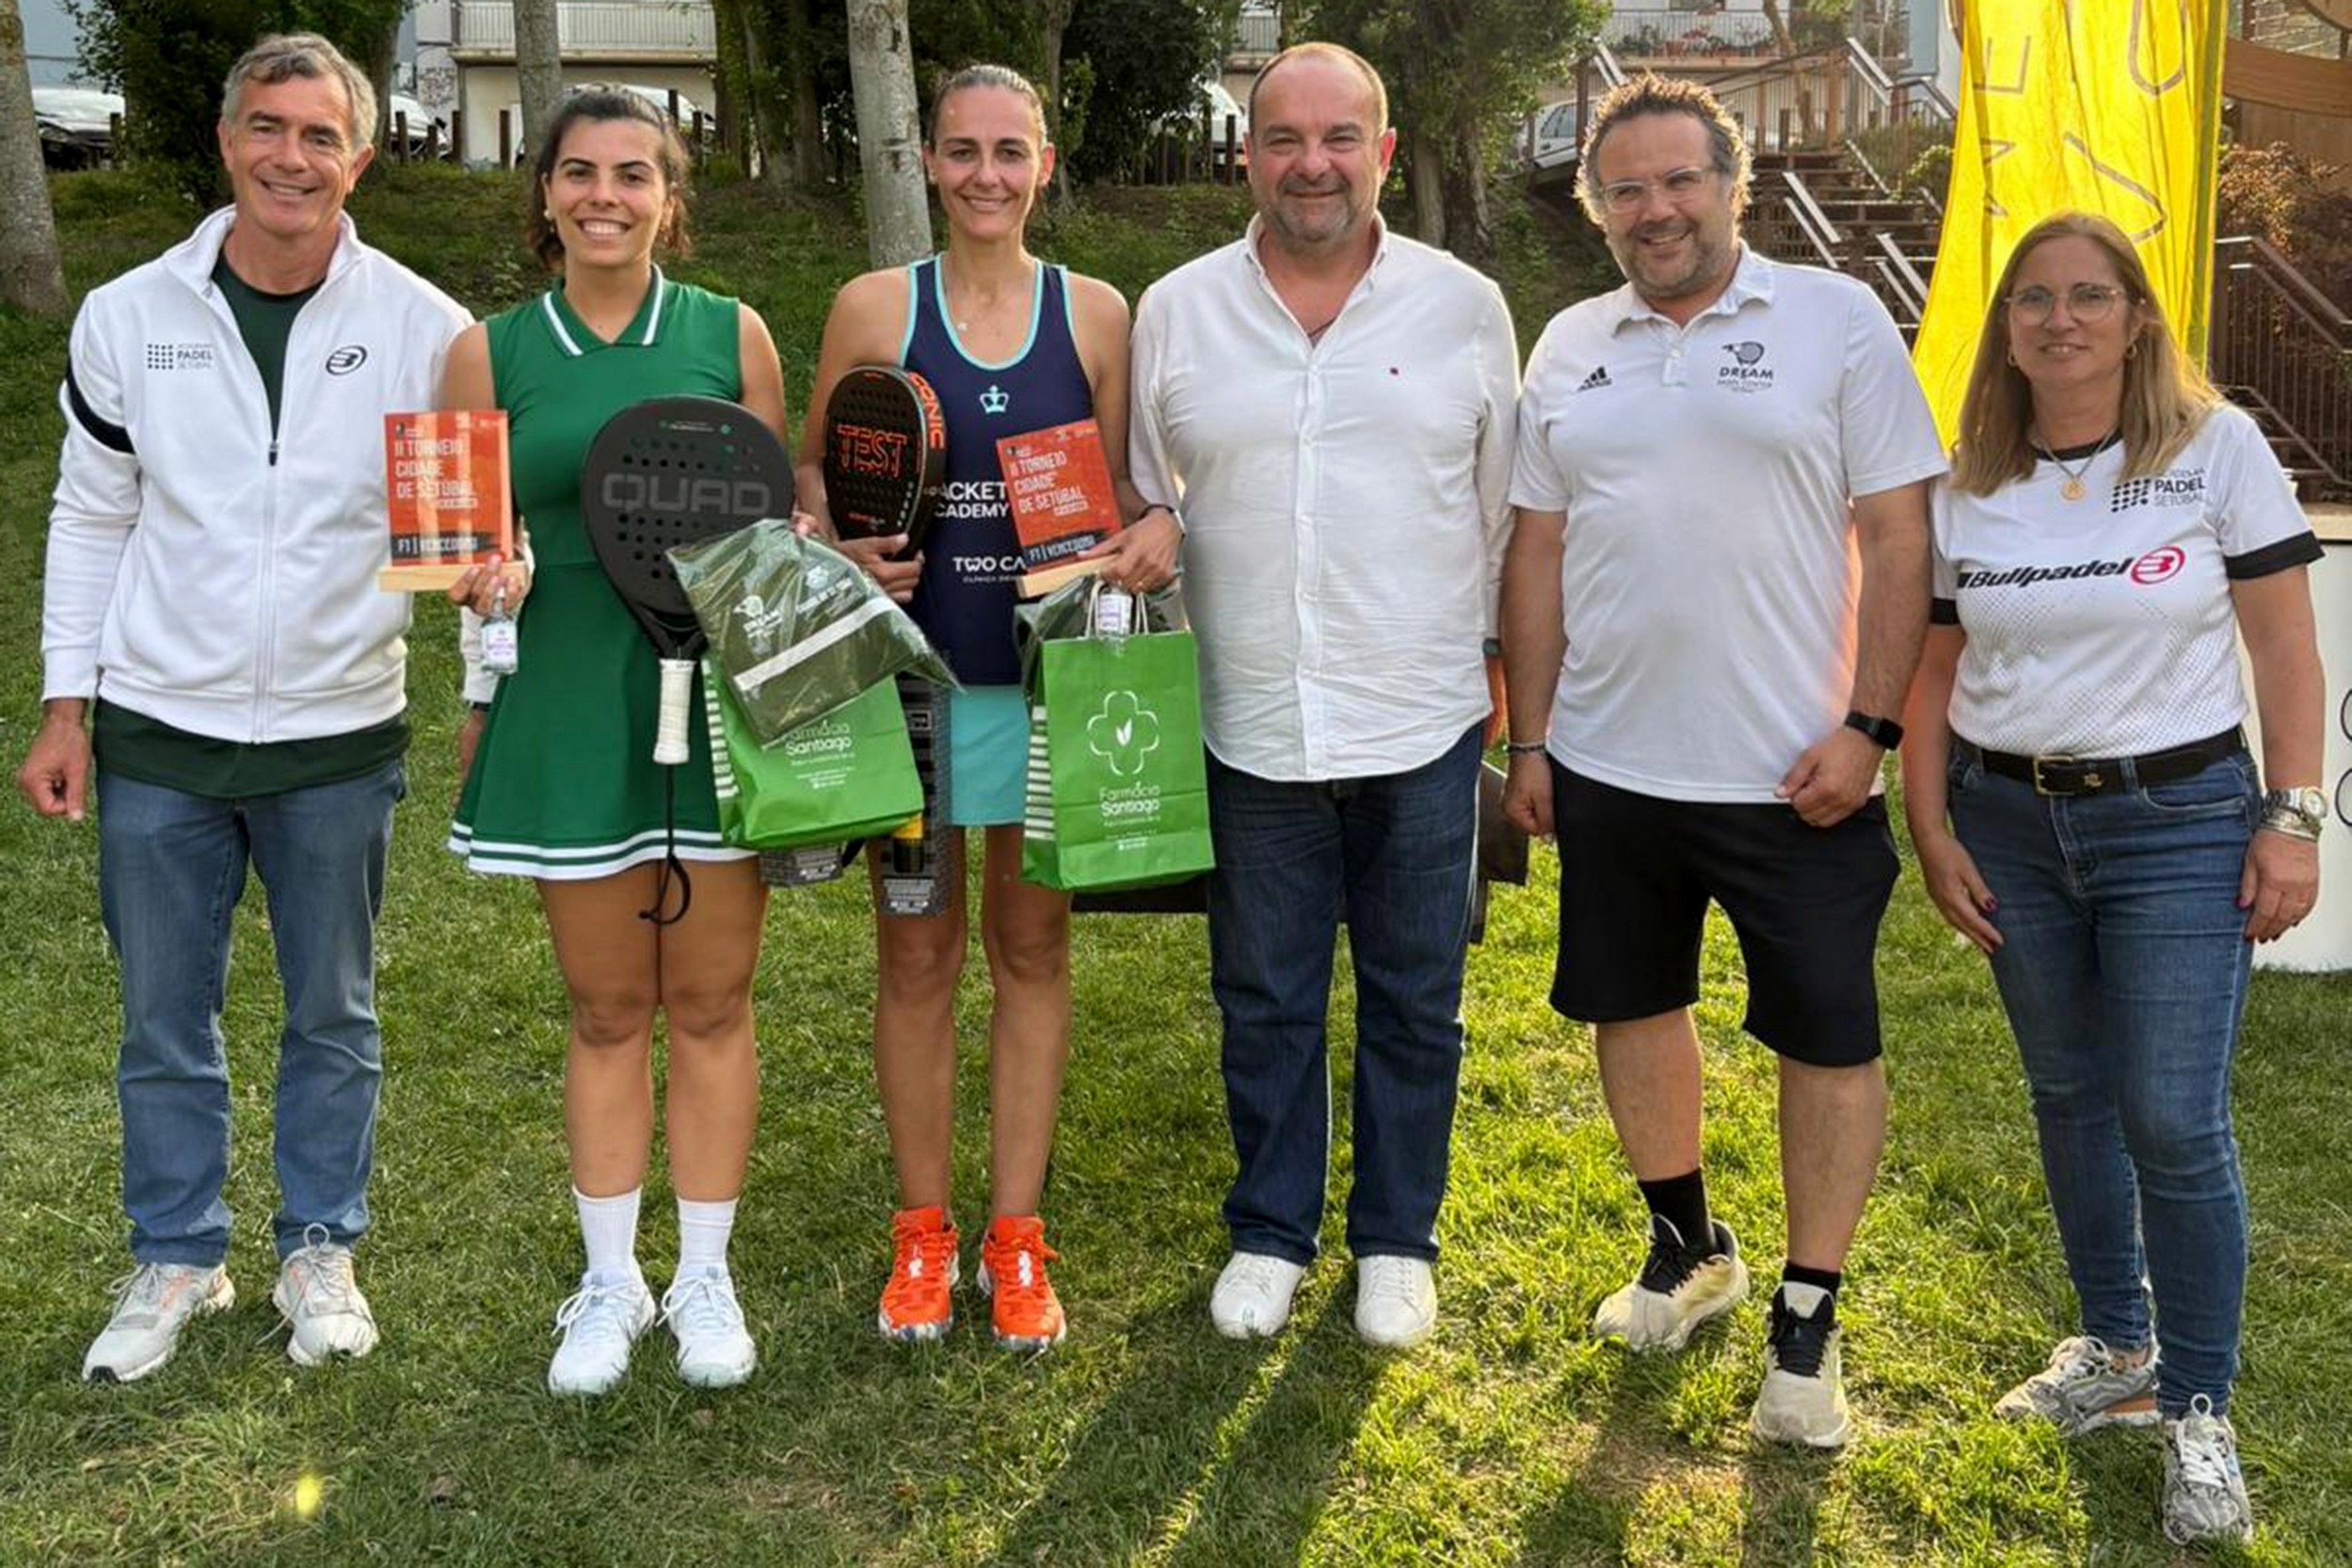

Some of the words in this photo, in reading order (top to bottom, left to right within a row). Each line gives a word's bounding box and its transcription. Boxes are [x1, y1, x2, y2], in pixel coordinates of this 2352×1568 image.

[177, 350, 213, 360] PADEL
[1719, 366, 1774, 380] DREAM
[407, 439, 464, 456] TORNEIO
[837, 424, 908, 478] TEST
[394, 459, 445, 478] CIDADE
[1018, 451, 1067, 474] TORNEIO
[396, 481, 415, 500] DE
[939, 481, 1007, 501] ACKET
[1014, 471, 1059, 495] CIDADE
[2154, 477, 2206, 492] PADEL
[602, 472, 771, 514] QUAD
[934, 503, 1010, 519] CADEMY
[1018, 495, 1035, 514] DE
[952, 555, 998, 572] TWO
[1000, 555, 1027, 572] CA
[1967, 556, 2136, 588] Bullpadel
[785, 735, 853, 757] Santiago
[1100, 798, 1161, 818] Santiago
